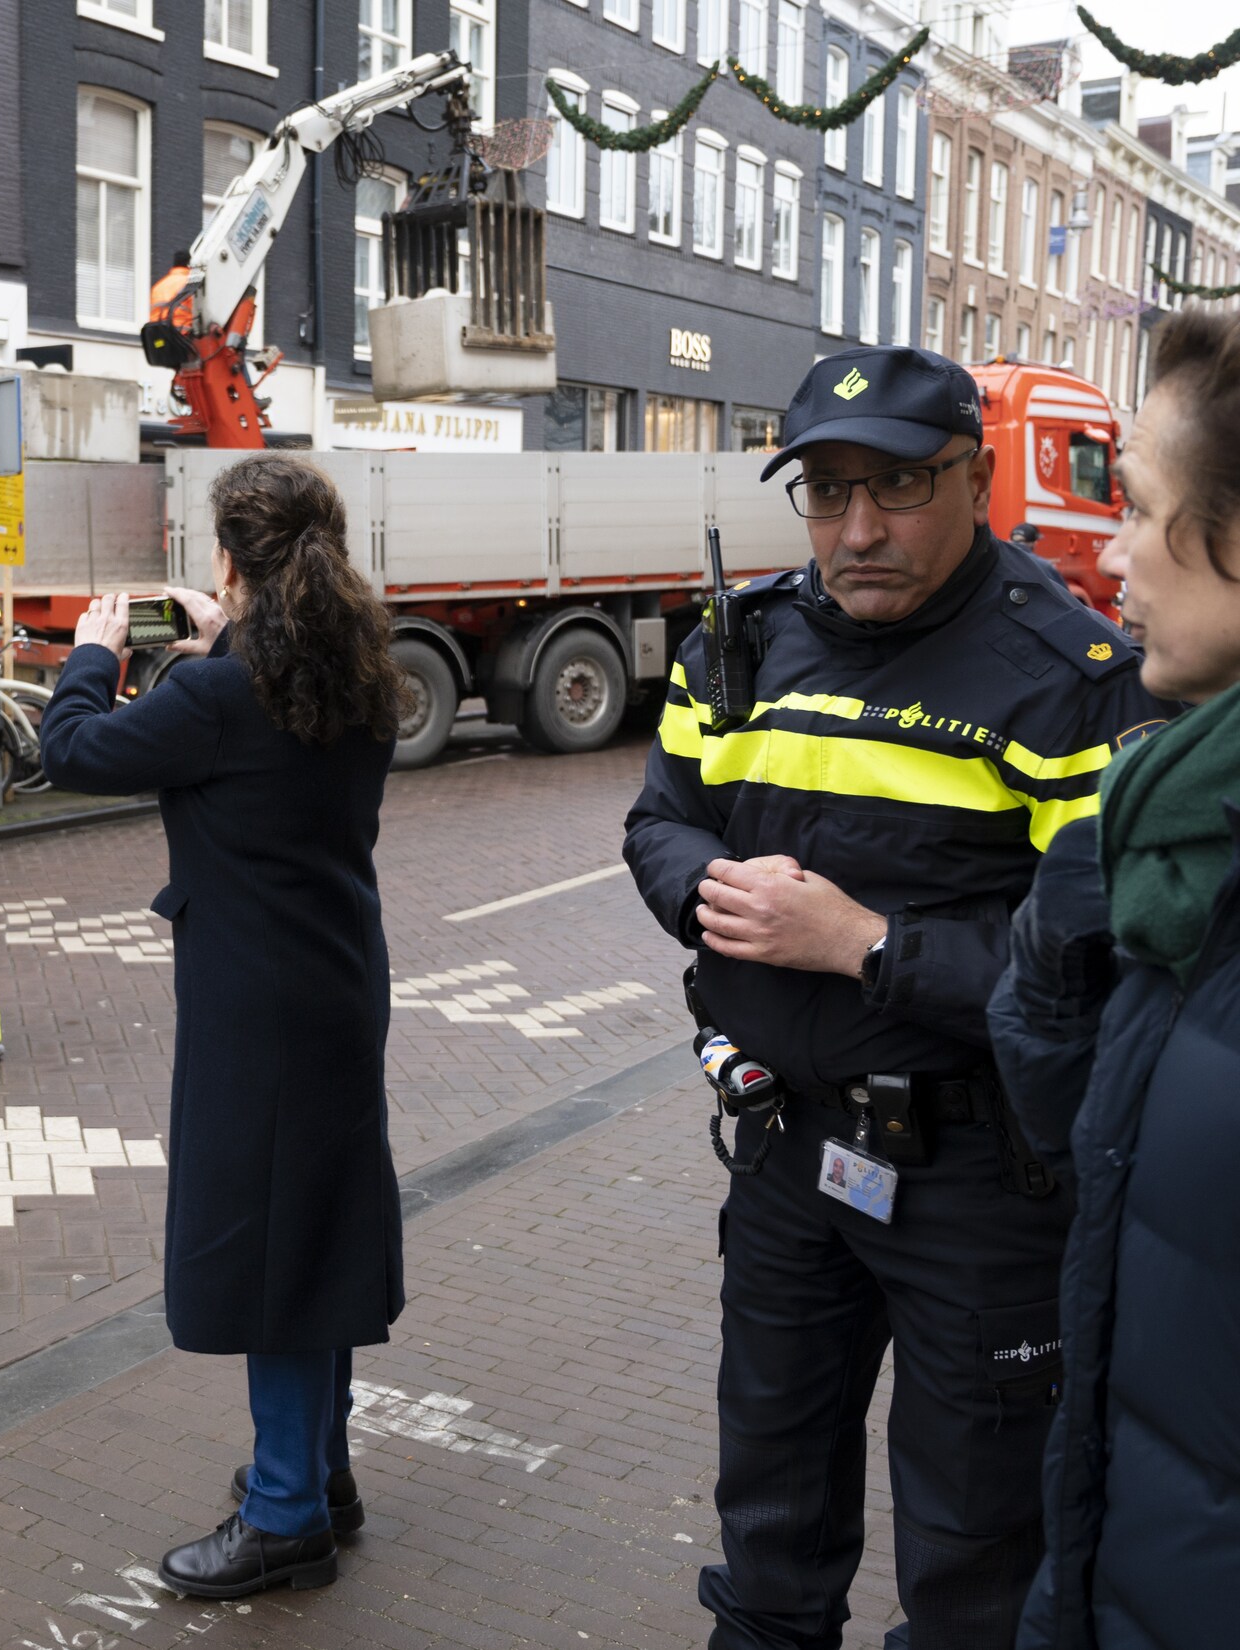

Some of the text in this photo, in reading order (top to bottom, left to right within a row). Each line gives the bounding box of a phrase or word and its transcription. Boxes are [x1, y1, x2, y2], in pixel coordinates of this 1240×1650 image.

[670, 328, 711, 362] BOSS
[434, 415, 500, 442] FILIPPI
[884, 702, 989, 743] POLITIE
